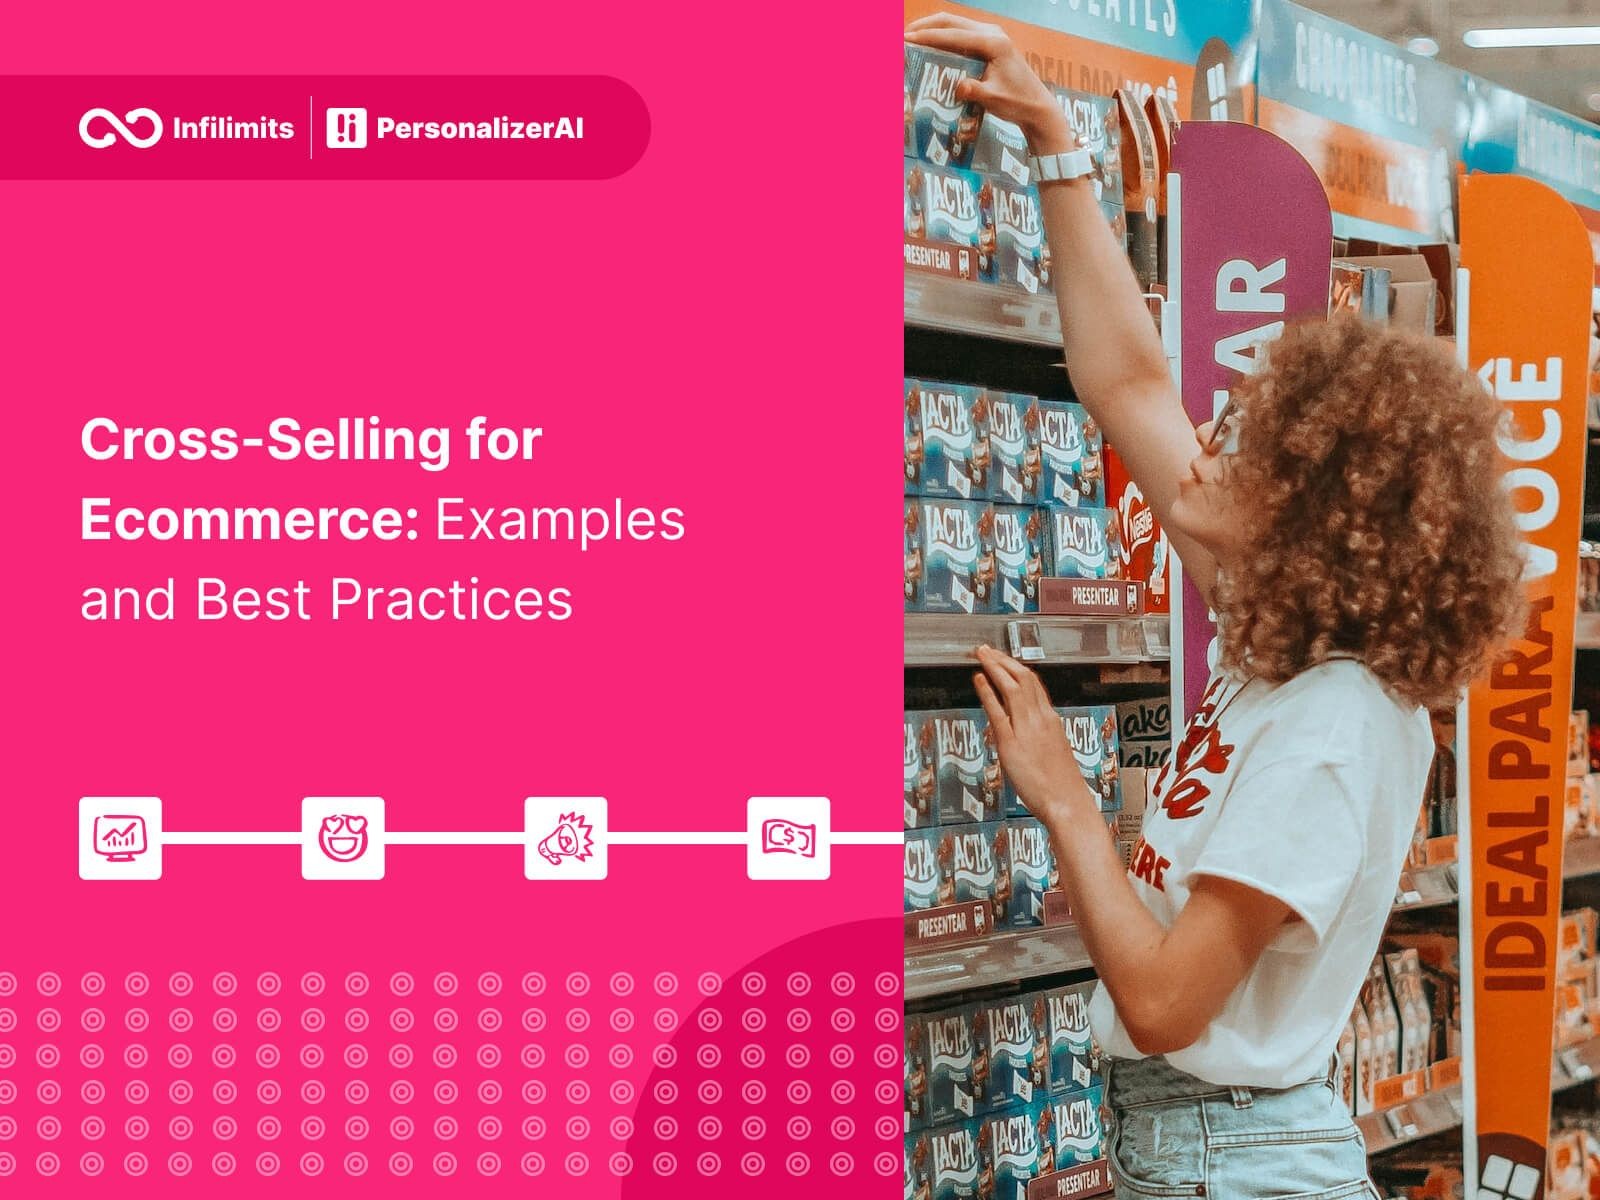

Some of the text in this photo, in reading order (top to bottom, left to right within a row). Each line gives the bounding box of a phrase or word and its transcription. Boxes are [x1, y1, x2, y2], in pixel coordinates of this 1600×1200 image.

[925, 173, 976, 223] LACTA
[920, 391, 971, 440] LACTA
[924, 505, 975, 556] LACTA
[1055, 513, 1102, 562] LACTA
[935, 719, 981, 768] LACTA
[954, 833, 993, 873] ACTA
[1008, 828, 1047, 876] LACTA
[1483, 795, 1550, 992] IDEAL
[918, 913, 967, 939] PRESENTEAR
[928, 1015, 970, 1071] LACTA
[987, 1004, 1031, 1057] LACTA
[1049, 992, 1089, 1045] LACTA
[992, 1114, 1036, 1170] LACTA
[1054, 1098, 1098, 1153] LACTA
[932, 1129, 976, 1186] LACTA
[1057, 1168, 1101, 1198] PRESENTEAR
